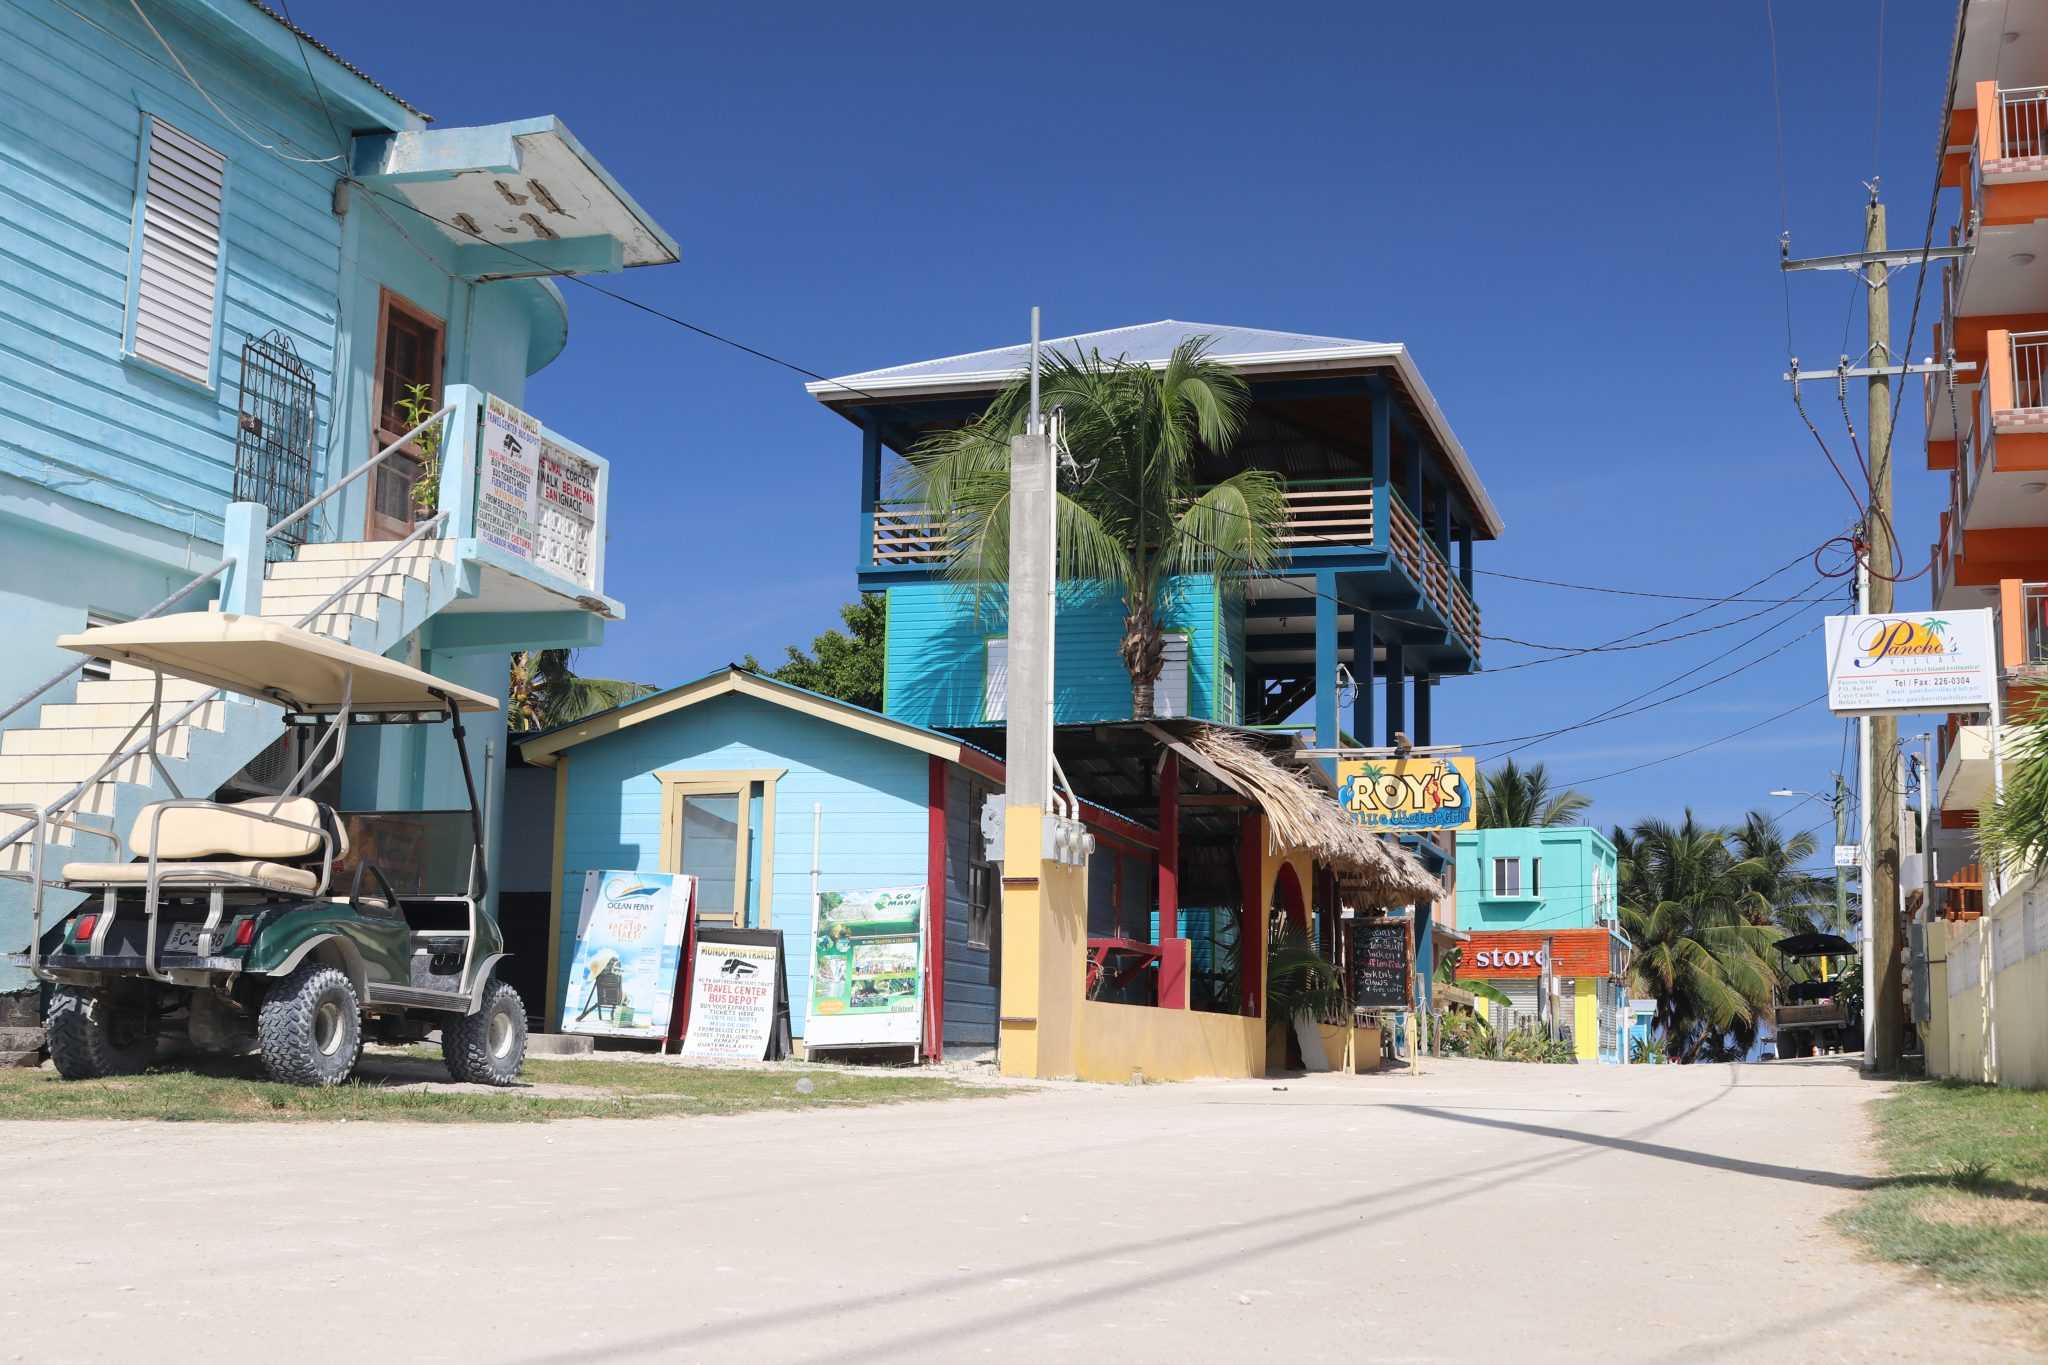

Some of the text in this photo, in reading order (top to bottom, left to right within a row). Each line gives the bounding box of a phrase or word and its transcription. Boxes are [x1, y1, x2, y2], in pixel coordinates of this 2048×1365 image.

[1351, 766, 1461, 810] ROY'S
[1476, 946, 1544, 967] store
[703, 984, 767, 996] TRAVEL CENTER
[709, 994, 758, 1005] BUS DEPOT
